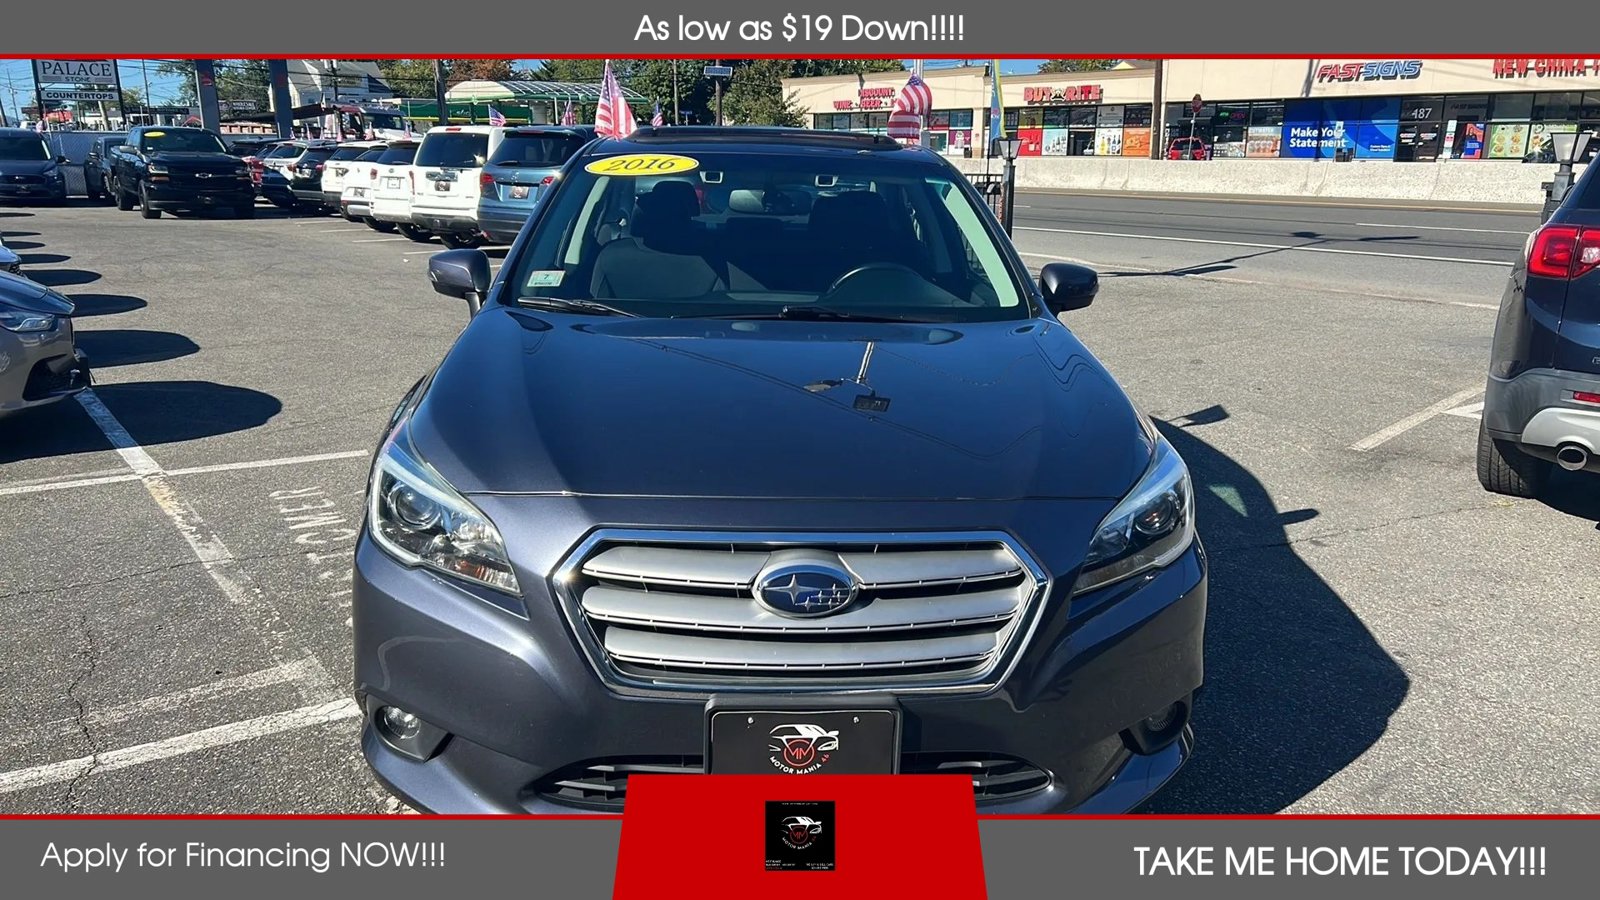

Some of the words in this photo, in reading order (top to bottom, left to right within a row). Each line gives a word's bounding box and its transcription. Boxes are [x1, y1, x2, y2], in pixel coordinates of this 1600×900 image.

[41, 61, 112, 77] PALACE
[1317, 60, 1422, 81] FASTSIGNS
[1493, 59, 1529, 78] NEW
[1534, 59, 1587, 77] CHINA
[46, 92, 114, 100] COUNTERTOPS
[1024, 86, 1052, 102] BUY
[1065, 84, 1101, 102] RITE
[1290, 127, 1319, 138] Make
[1289, 138, 1348, 148] Statement
[603, 158, 682, 171] 2016
[769, 755, 795, 775] MOTOR
[796, 762, 822, 775] MANIA
